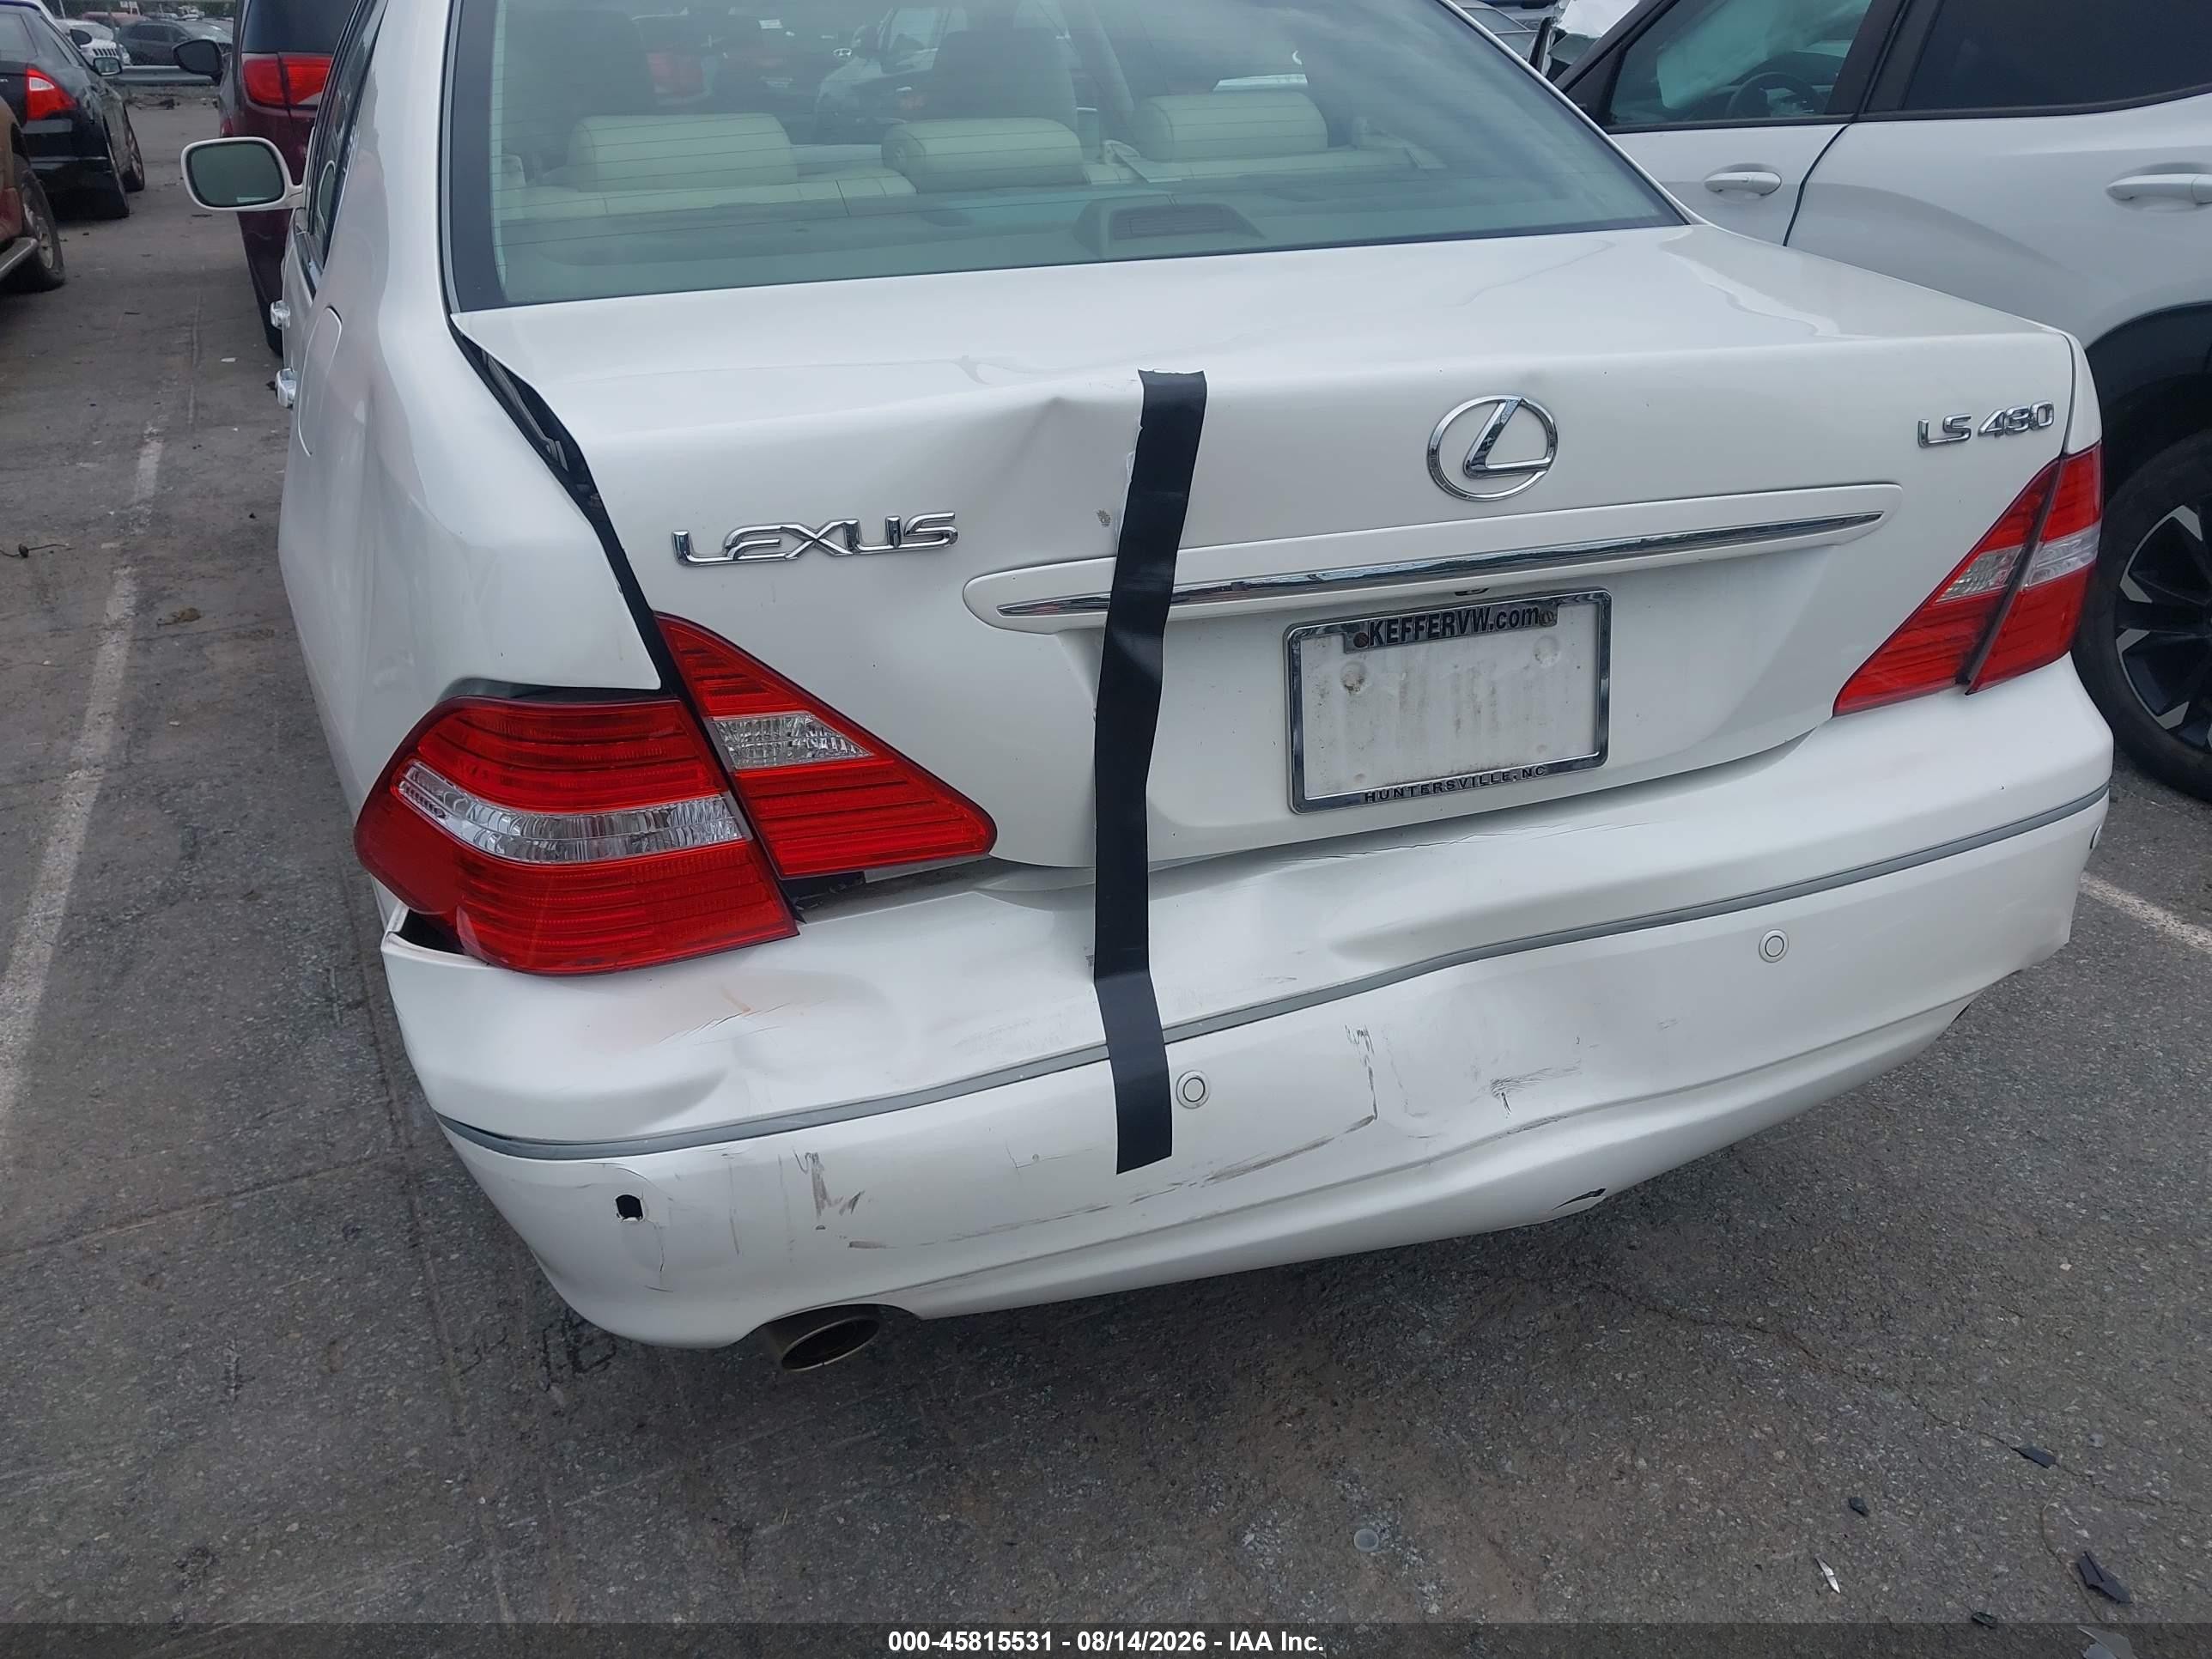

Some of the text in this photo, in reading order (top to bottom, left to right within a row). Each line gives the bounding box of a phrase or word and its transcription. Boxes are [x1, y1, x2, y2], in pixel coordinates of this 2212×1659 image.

[1917, 400, 2054, 447] LS 430
[672, 512, 958, 567] LEXUS
[1370, 606, 1540, 647] KEFFERVW.com
[1522, 766, 1546, 779] NC
